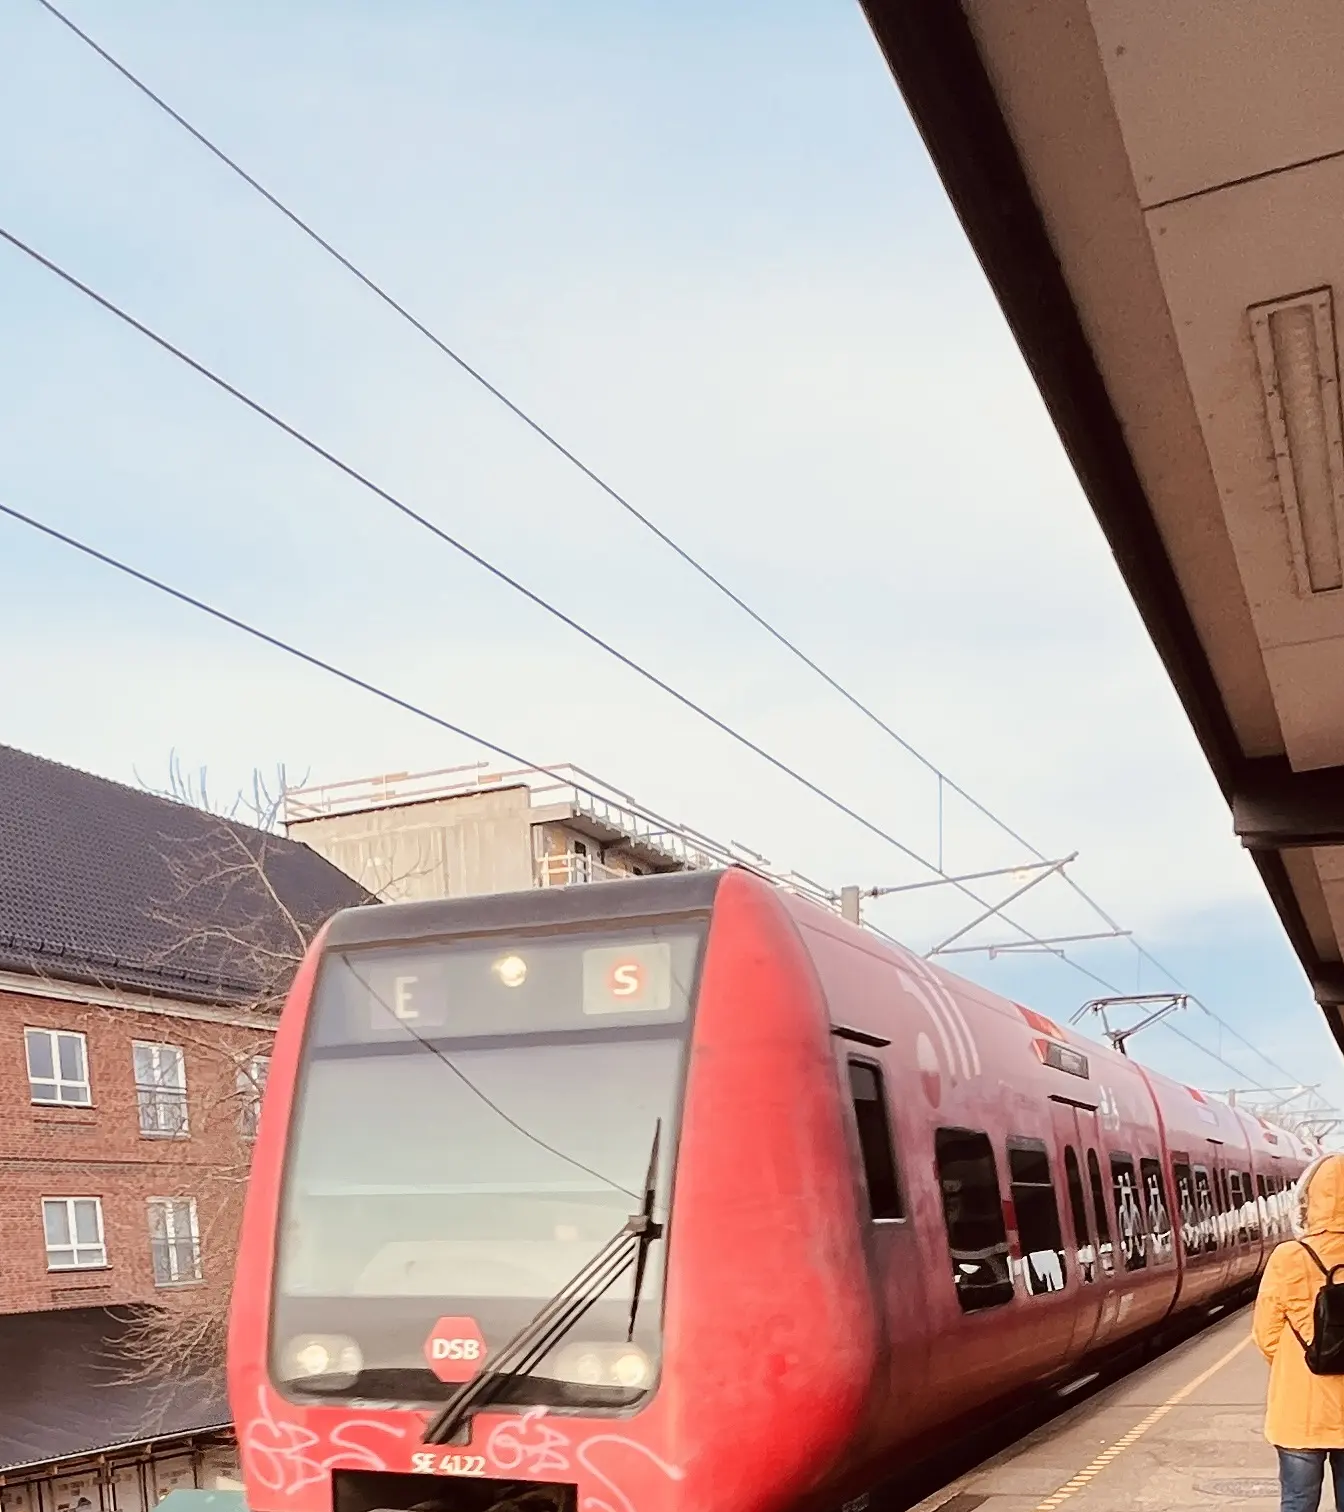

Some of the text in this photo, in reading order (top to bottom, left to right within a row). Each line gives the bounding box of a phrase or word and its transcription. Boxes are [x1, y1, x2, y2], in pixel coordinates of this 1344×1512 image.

[612, 964, 639, 996] S
[395, 976, 419, 1019] E
[431, 1338, 480, 1360] DSB
[411, 1452, 486, 1476] SE 4122
